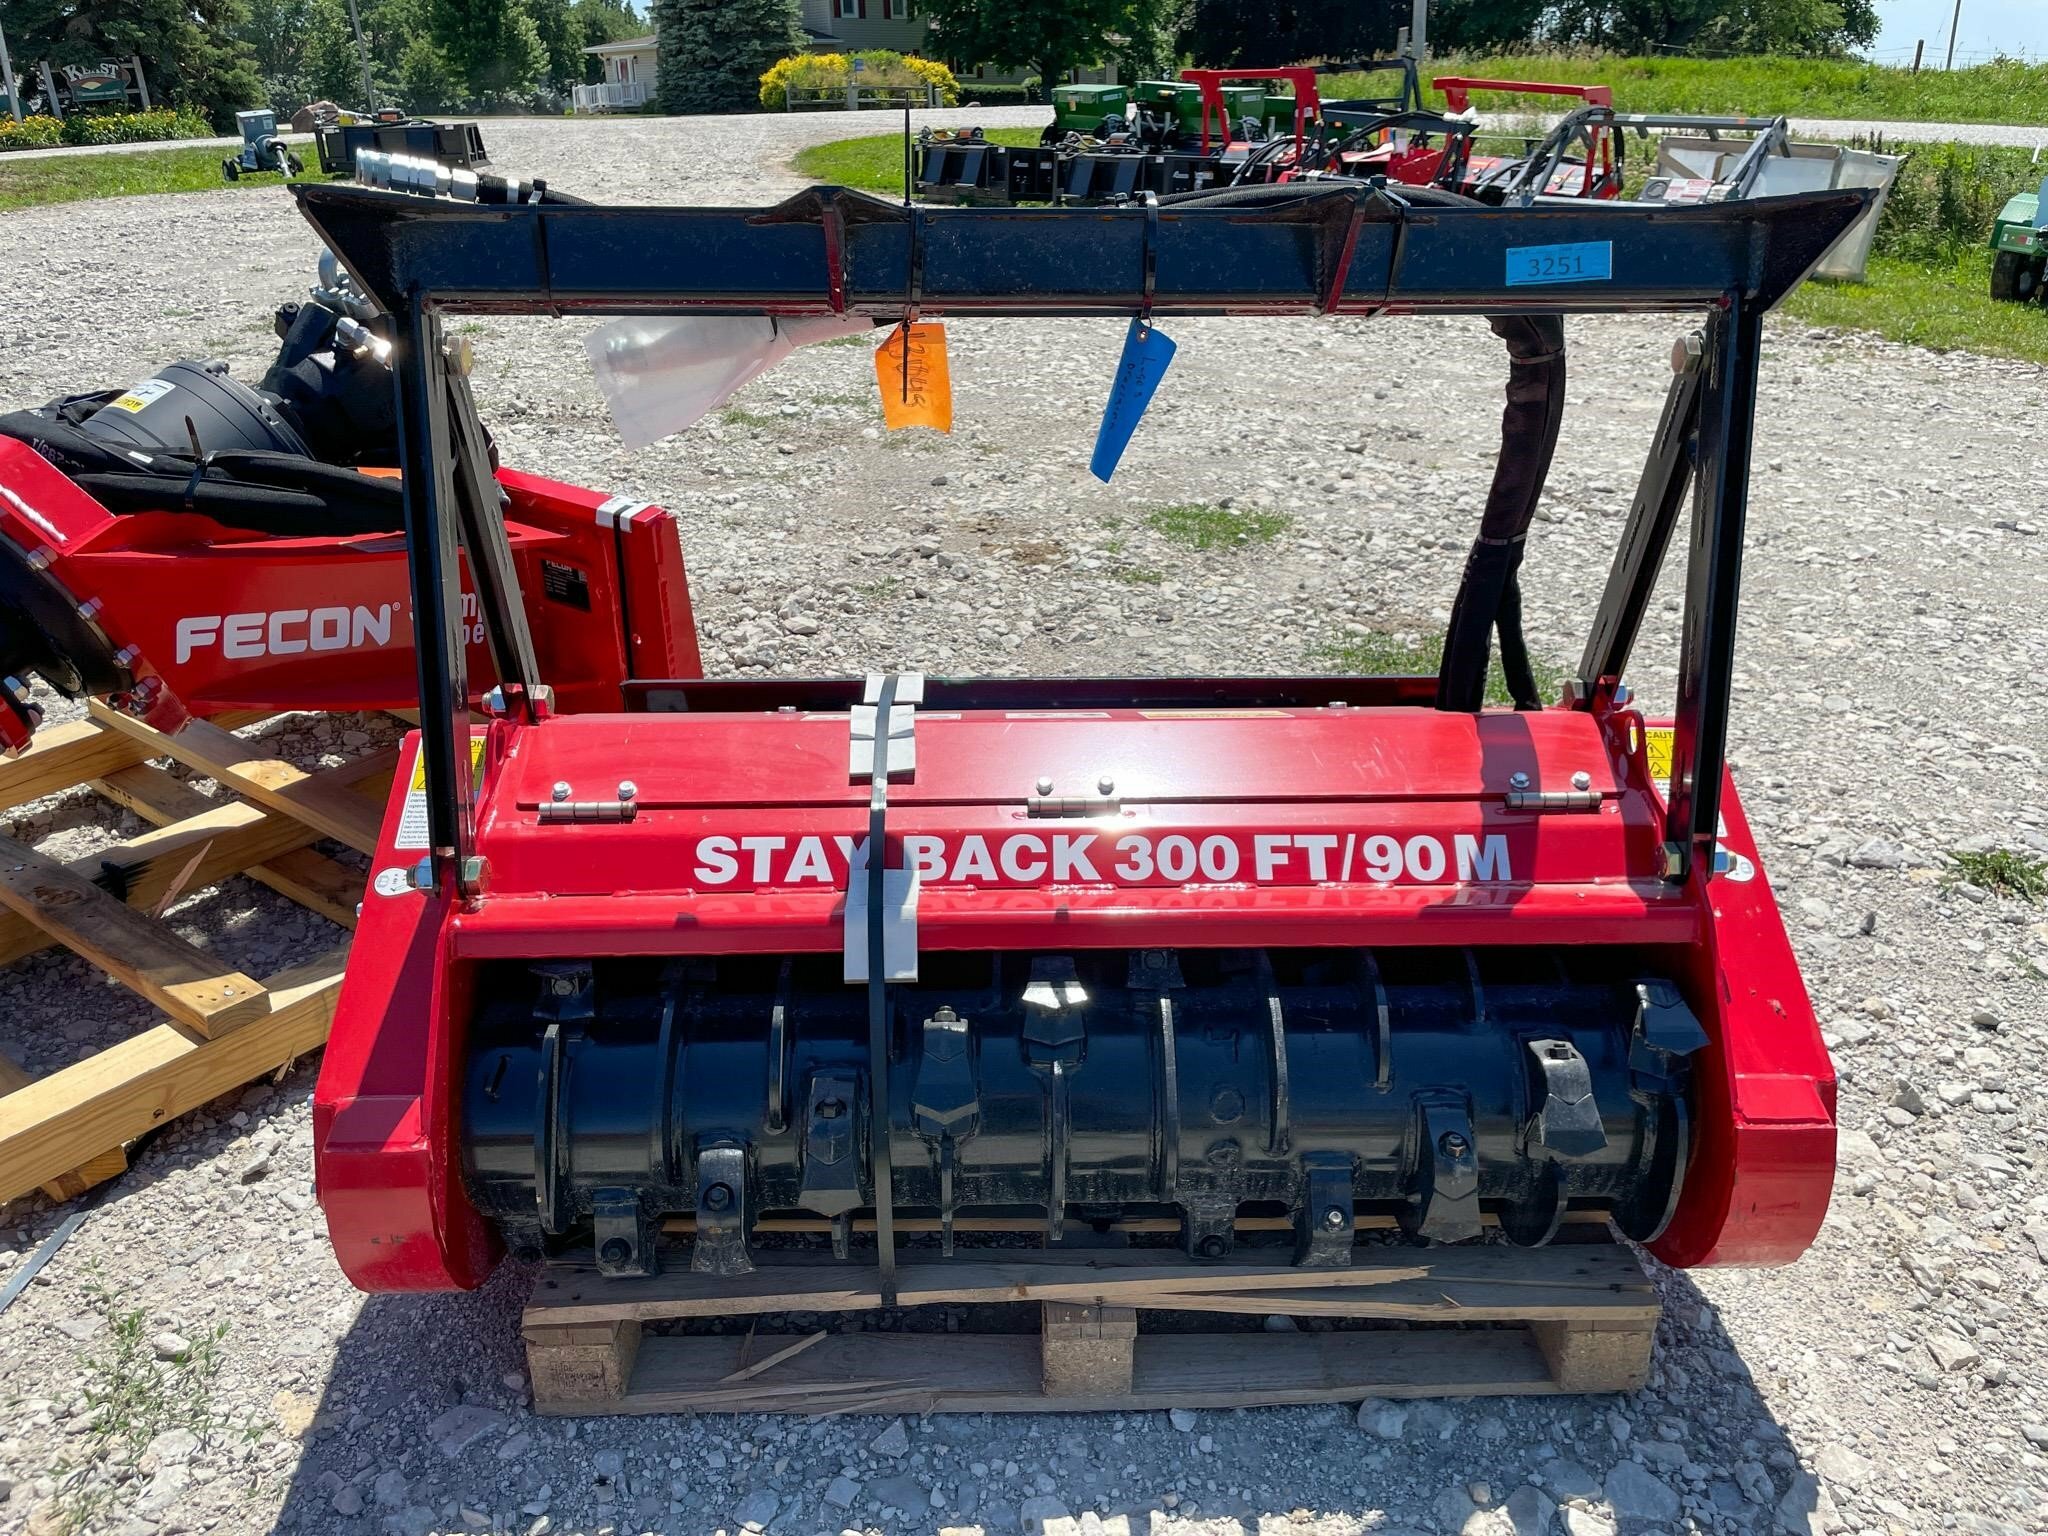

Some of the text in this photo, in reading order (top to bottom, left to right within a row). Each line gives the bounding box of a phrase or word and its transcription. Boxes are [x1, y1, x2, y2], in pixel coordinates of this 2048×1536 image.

[1527, 256, 1585, 277] 3251
[176, 603, 392, 665] FECON
[693, 834, 1513, 884] STAY BACK 300 FT/90 M
